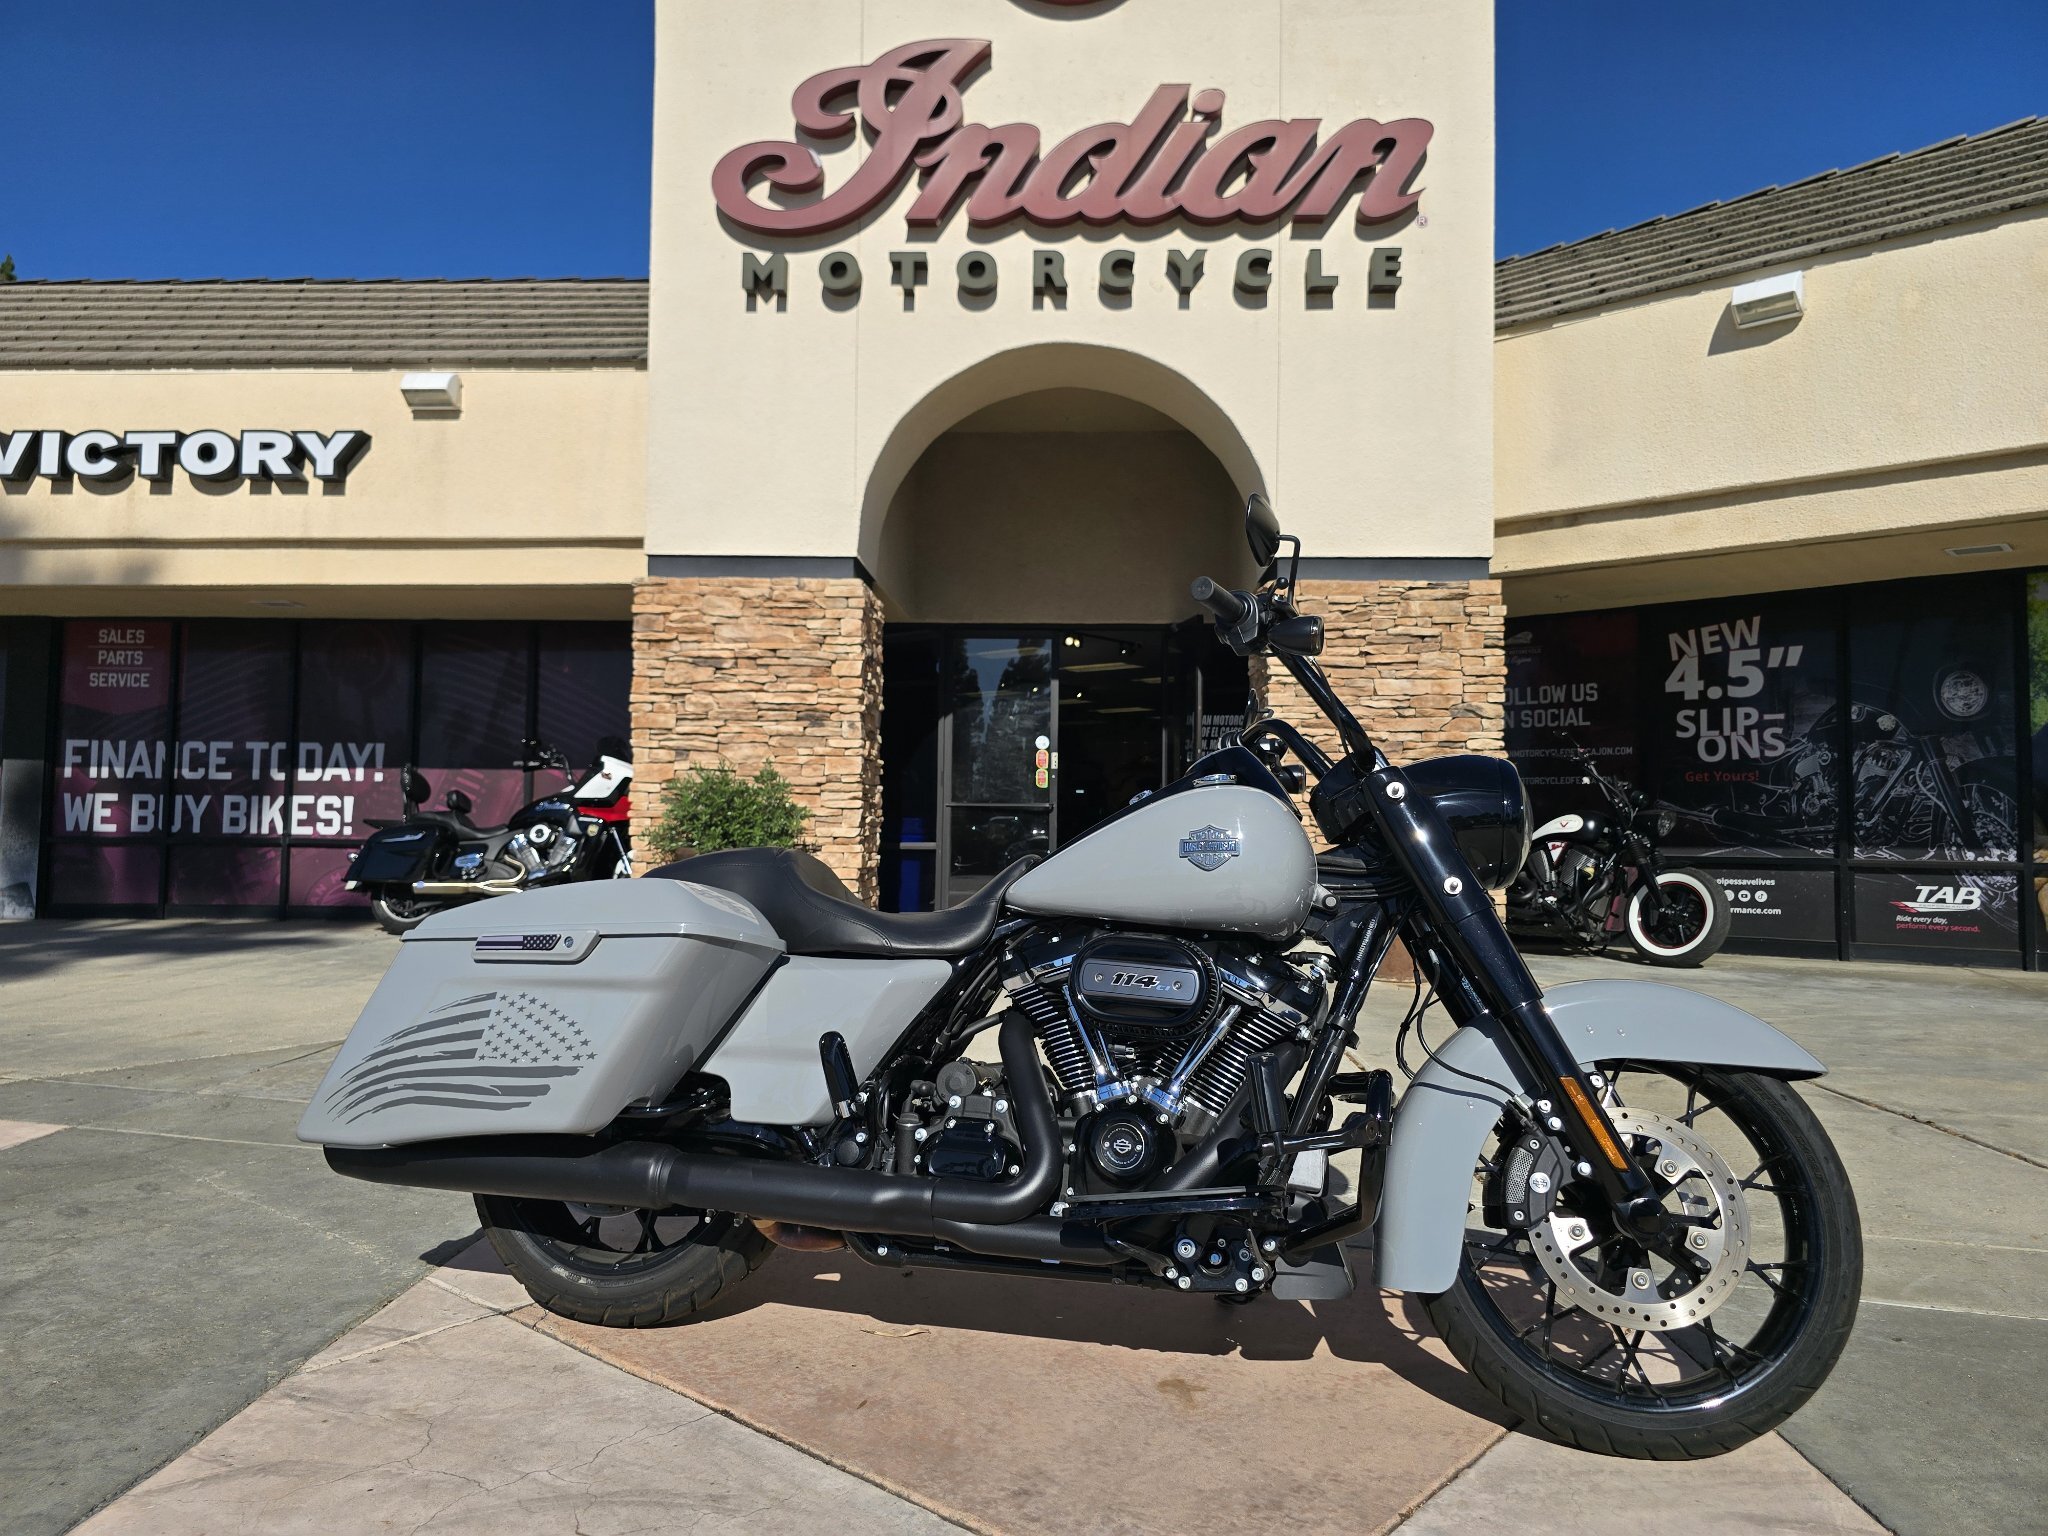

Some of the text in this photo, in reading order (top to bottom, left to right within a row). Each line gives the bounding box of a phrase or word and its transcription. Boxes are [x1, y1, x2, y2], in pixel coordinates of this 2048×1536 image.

[711, 38, 1435, 231] Indian
[741, 247, 1403, 294] MOTORCYCLE
[98, 629, 145, 644] SALES
[1668, 615, 1761, 661] NEW
[97, 650, 144, 665] PARTS
[88, 671, 151, 688] SERVICE
[1503, 682, 1599, 706] OLLOW US
[1213, 714, 1245, 726] MOTORC
[1504, 707, 1592, 729] N SOCIAL
[1675, 706, 1786, 738] SLIP-
[1697, 727, 1786, 763] ONS
[63, 739, 386, 782] FINANCE TODAY!
[1685, 770, 1760, 783] Get Yours!
[63, 792, 355, 837] WE BUY BIKES!
[1915, 885, 1982, 910] TAB
[1729, 907, 1782, 915] rmance.com
[1895, 915, 1911, 923] Ride
[1912, 916, 1932, 925] every
[1928, 924, 1949, 932] every
[1111, 971, 1161, 989] 114
